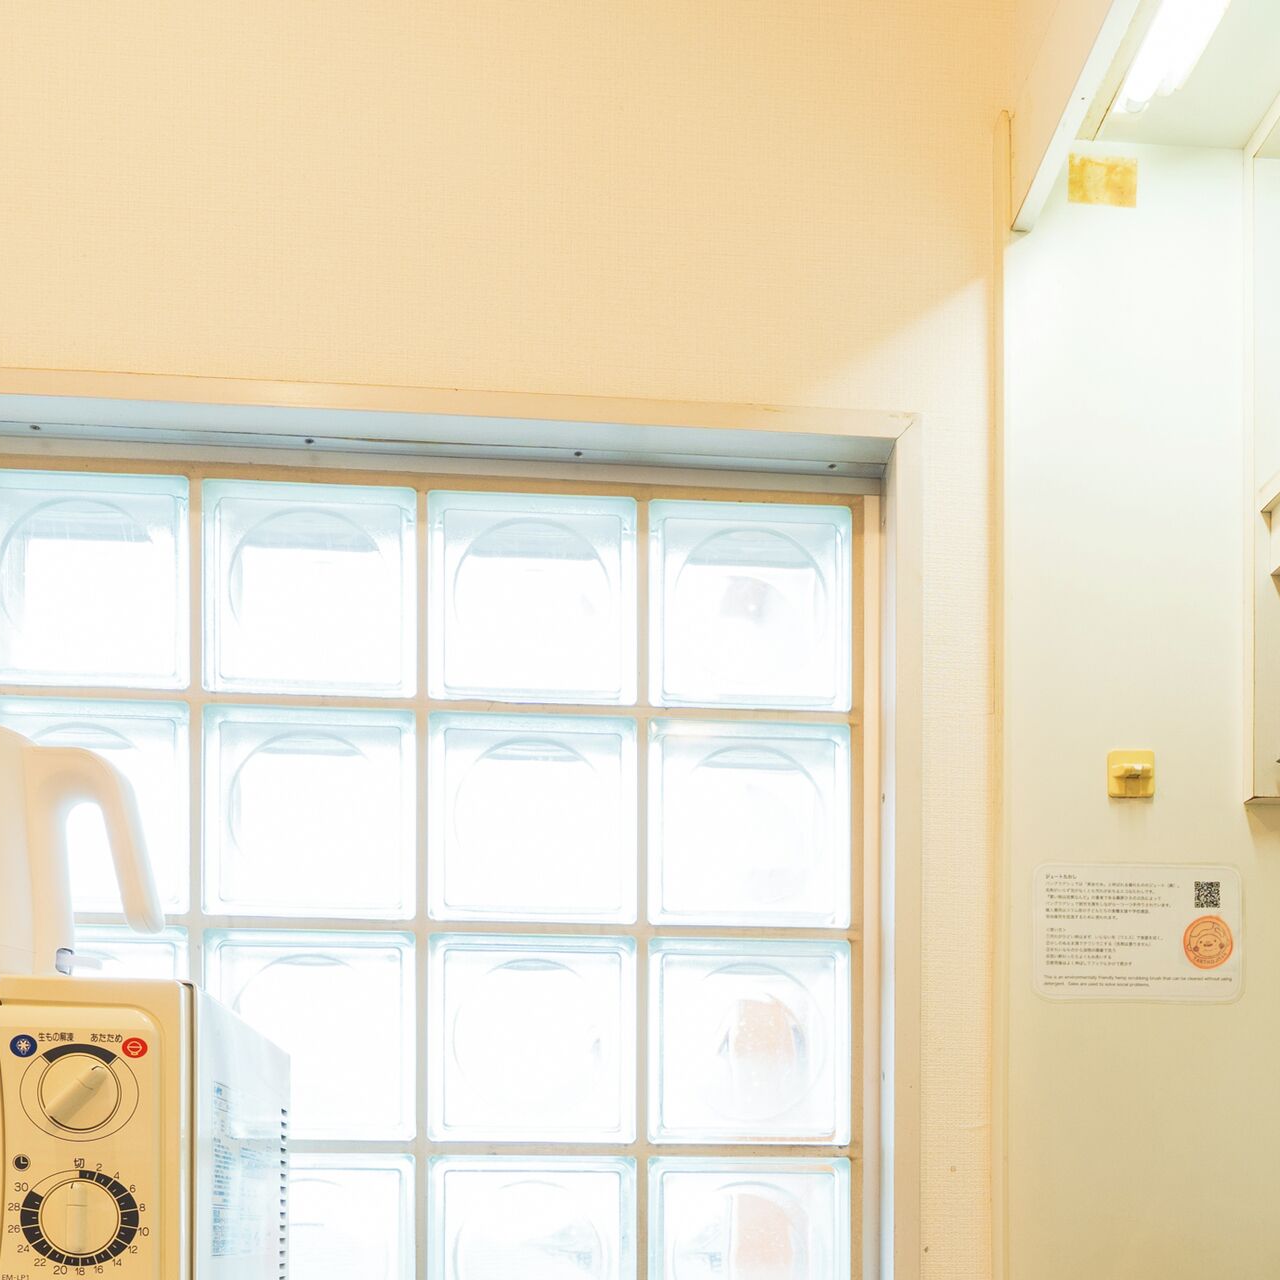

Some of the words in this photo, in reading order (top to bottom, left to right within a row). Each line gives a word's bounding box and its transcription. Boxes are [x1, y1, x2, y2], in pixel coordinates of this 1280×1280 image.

[38, 1032, 75, 1042] 生もの解凍
[90, 1033, 123, 1043] あたため
[74, 1158, 85, 1169] 切
[96, 1163, 103, 1172] 2
[113, 1172, 120, 1180] 4
[14, 1182, 29, 1192] 30
[129, 1184, 136, 1193] 6
[8, 1203, 20, 1211] 28
[139, 1203, 146, 1212] 8
[8, 1224, 20, 1233] 26
[137, 1227, 150, 1236] 10
[17, 1245, 30, 1253] 24
[128, 1245, 138, 1254] 12
[34, 1258, 47, 1267] 22
[112, 1258, 122, 1267] 14
[53, 1265, 68, 1275] 20
[75, 1267, 85, 1276] 18
[94, 1265, 104, 1274] 16
